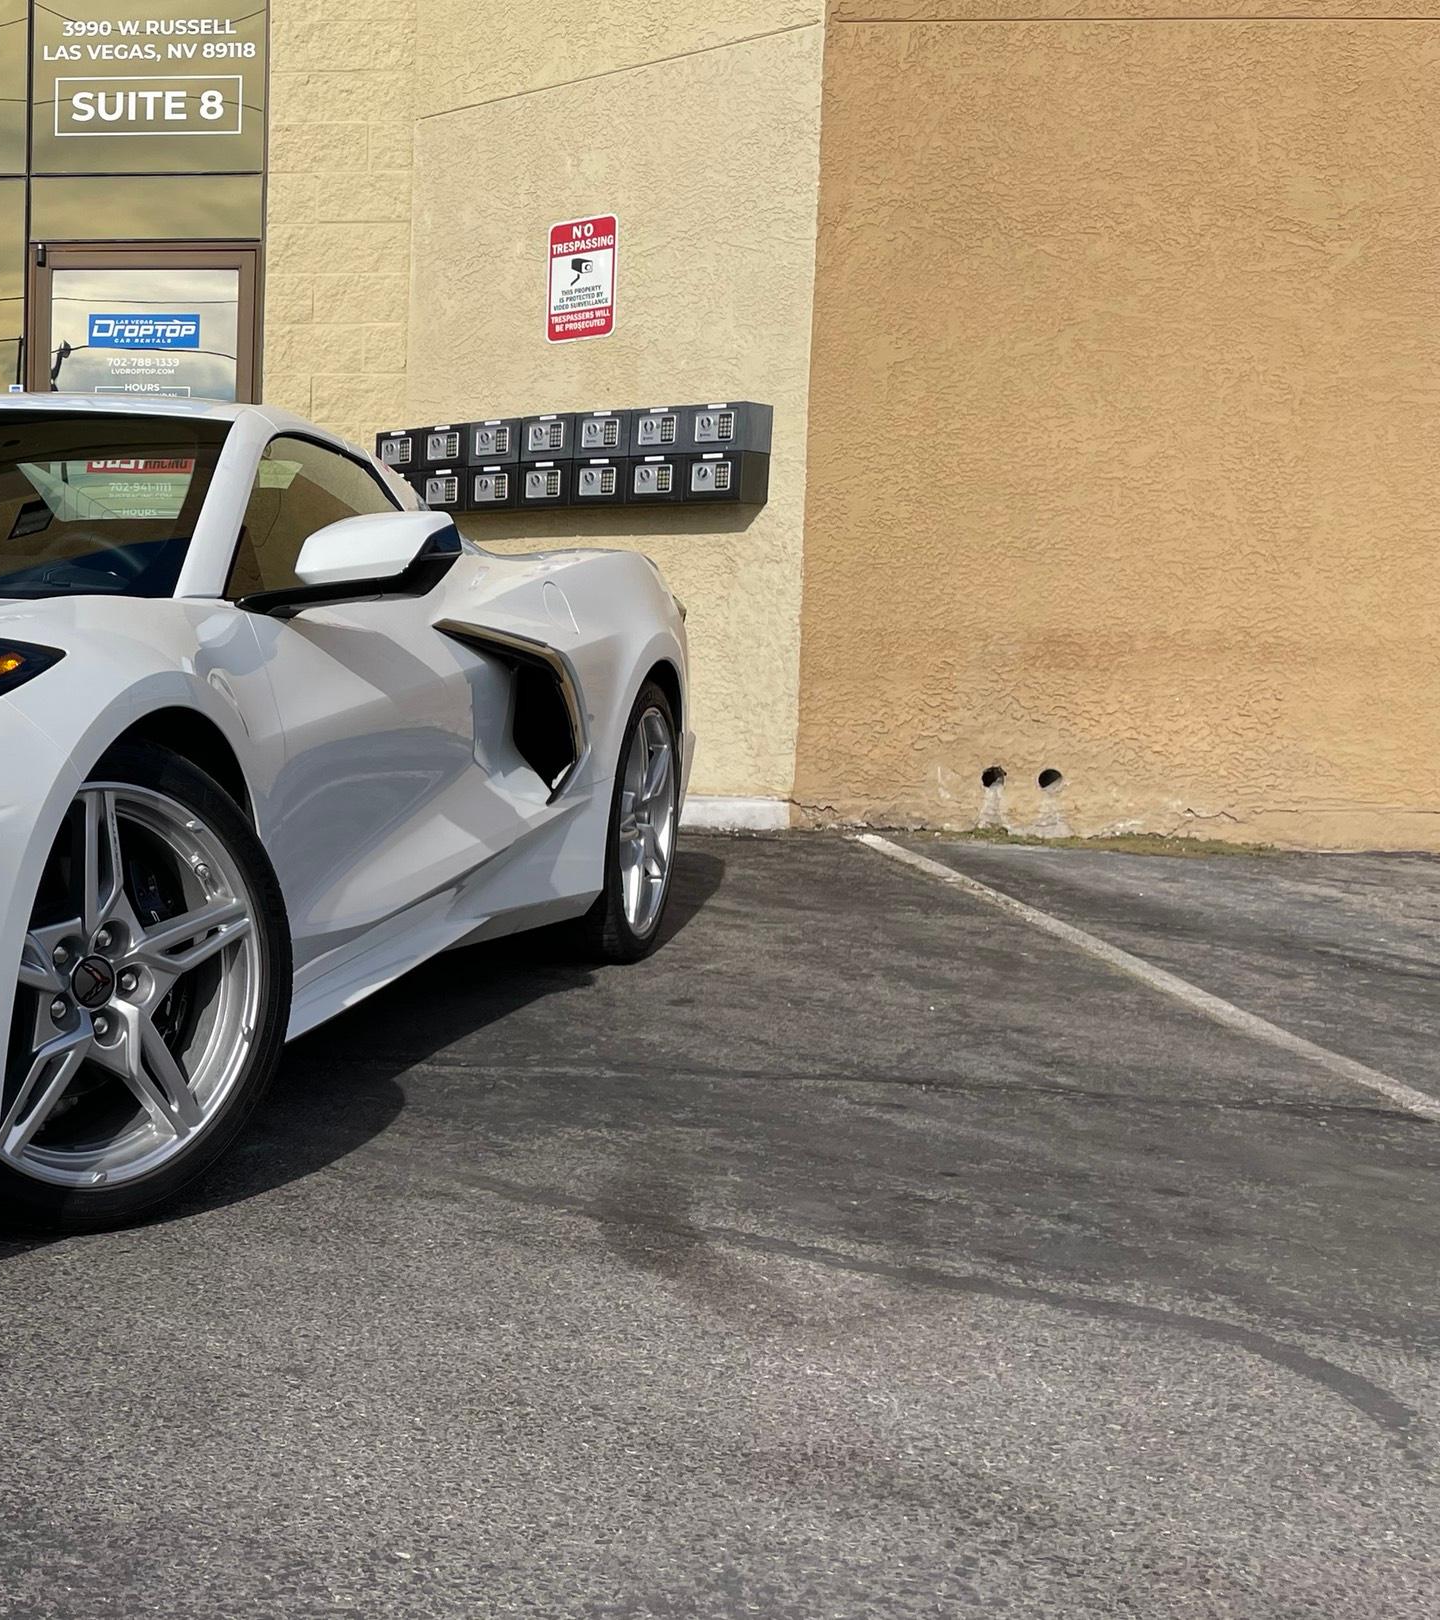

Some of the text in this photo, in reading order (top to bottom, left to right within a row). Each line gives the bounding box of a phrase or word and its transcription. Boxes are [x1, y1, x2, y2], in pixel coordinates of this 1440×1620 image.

[62, 19, 237, 37] 3990 W. RUSSELL
[43, 42, 256, 63] LAS VEGAS, NV 89118
[71, 89, 224, 122] SUITE 8
[572, 222, 594, 240] NO
[552, 234, 614, 256] TRESPASSING
[561, 284, 602, 297] THIS PROPERTY
[565, 292, 596, 303] PROTECTED
[596, 291, 604, 299] BY
[553, 297, 609, 312] VIDEO SURVEILLANCE
[551, 308, 611, 325] TRESPASSERS WILL
[555, 318, 606, 333] BE PROSECUTED
[106, 357, 180, 367] 702-788-1339
[124, 383, 160, 392] HOURS
[122, 509, 158, 517] HOURS
